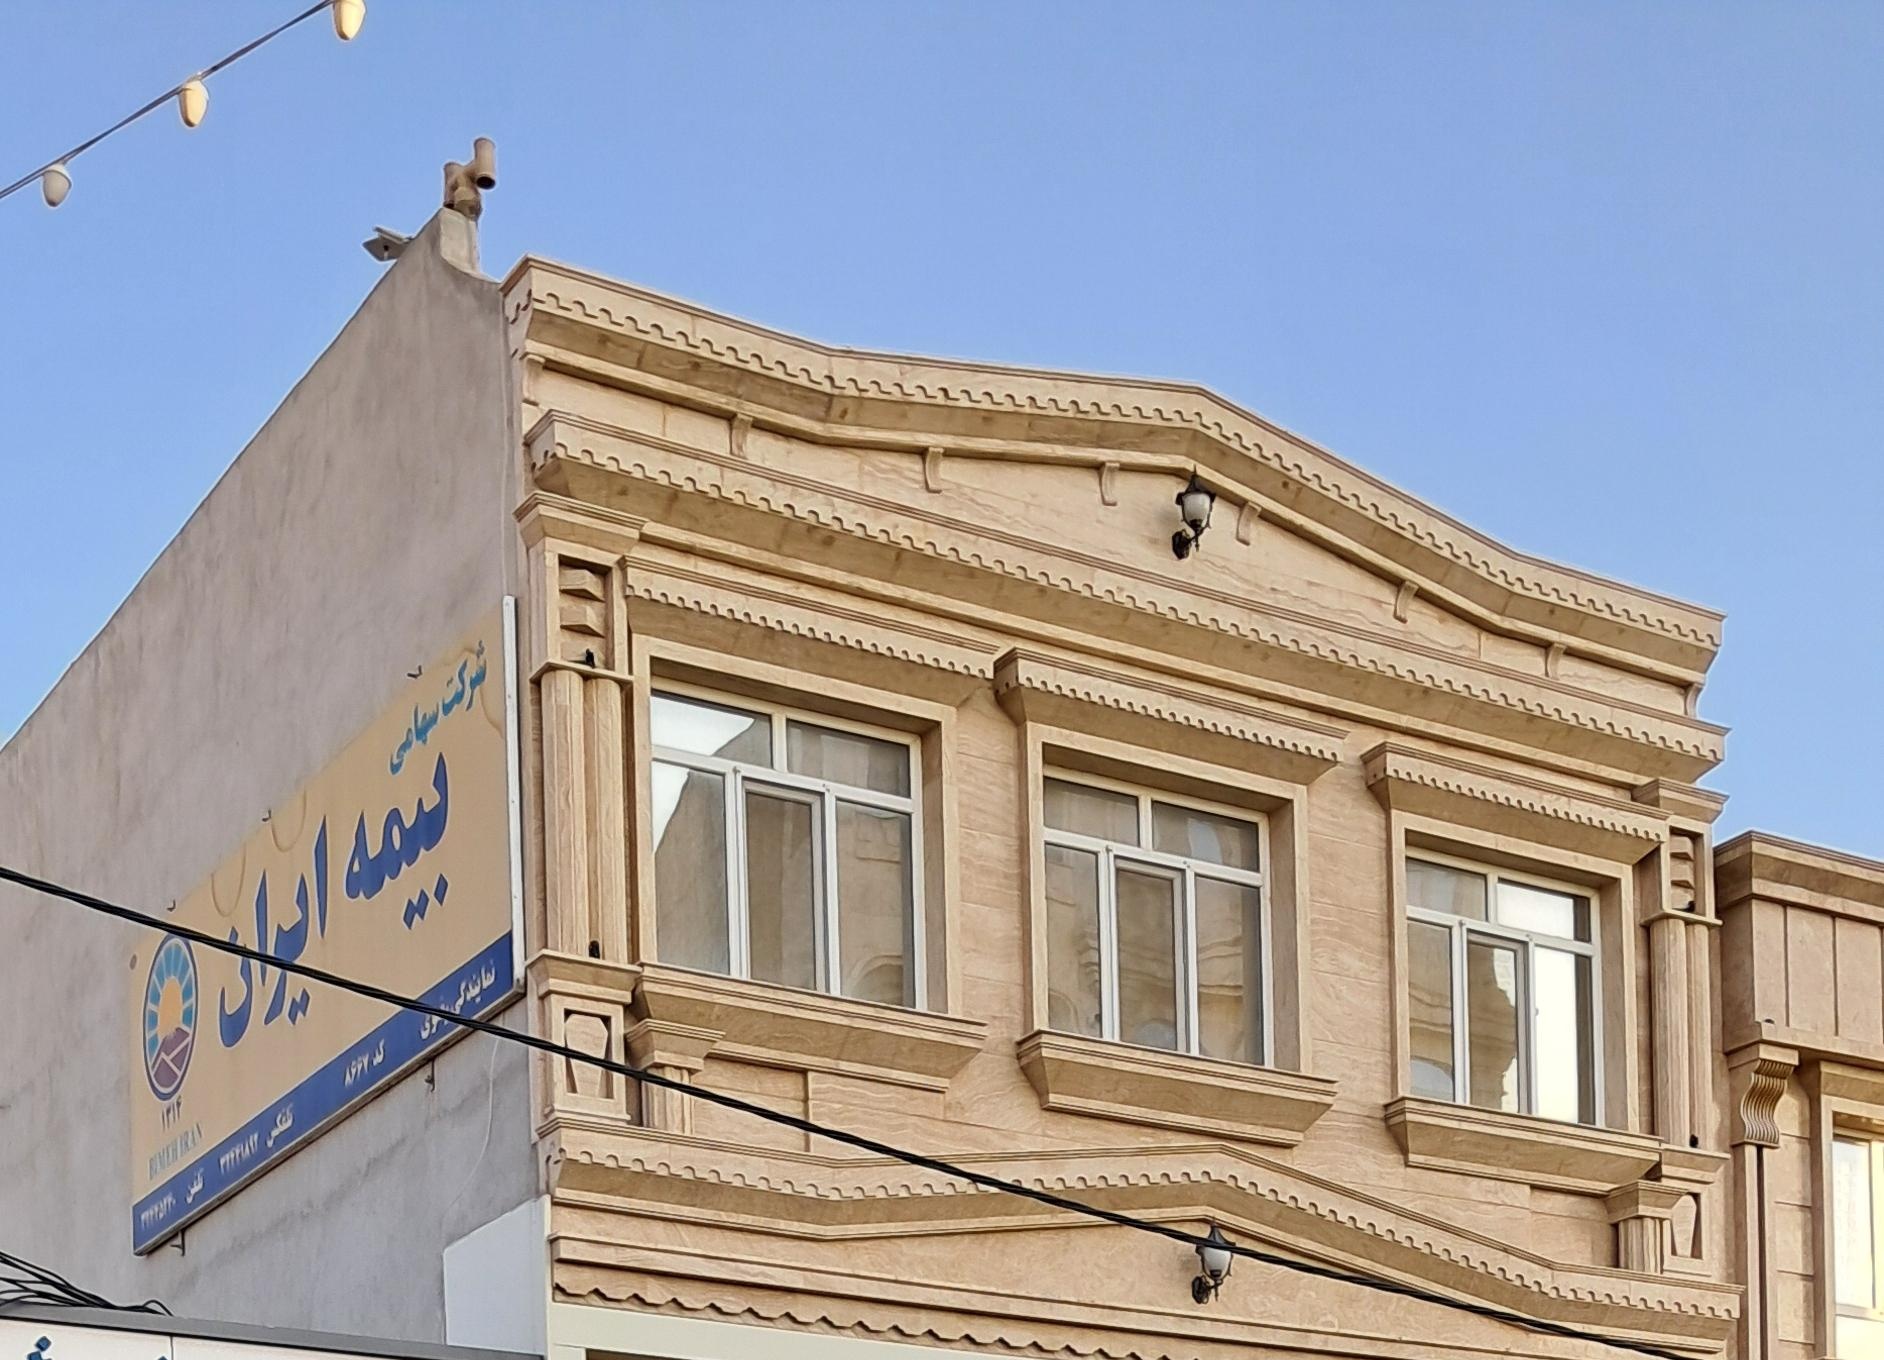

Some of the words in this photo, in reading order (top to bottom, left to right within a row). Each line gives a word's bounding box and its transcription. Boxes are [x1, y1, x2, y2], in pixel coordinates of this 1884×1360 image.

[441, 640, 488, 712] شرکت
[389, 699, 440, 775] سهامی
[344, 751, 449, 930] بیمه
[218, 813, 328, 1049] ایران
[371, 1038, 385, 1067] کد
